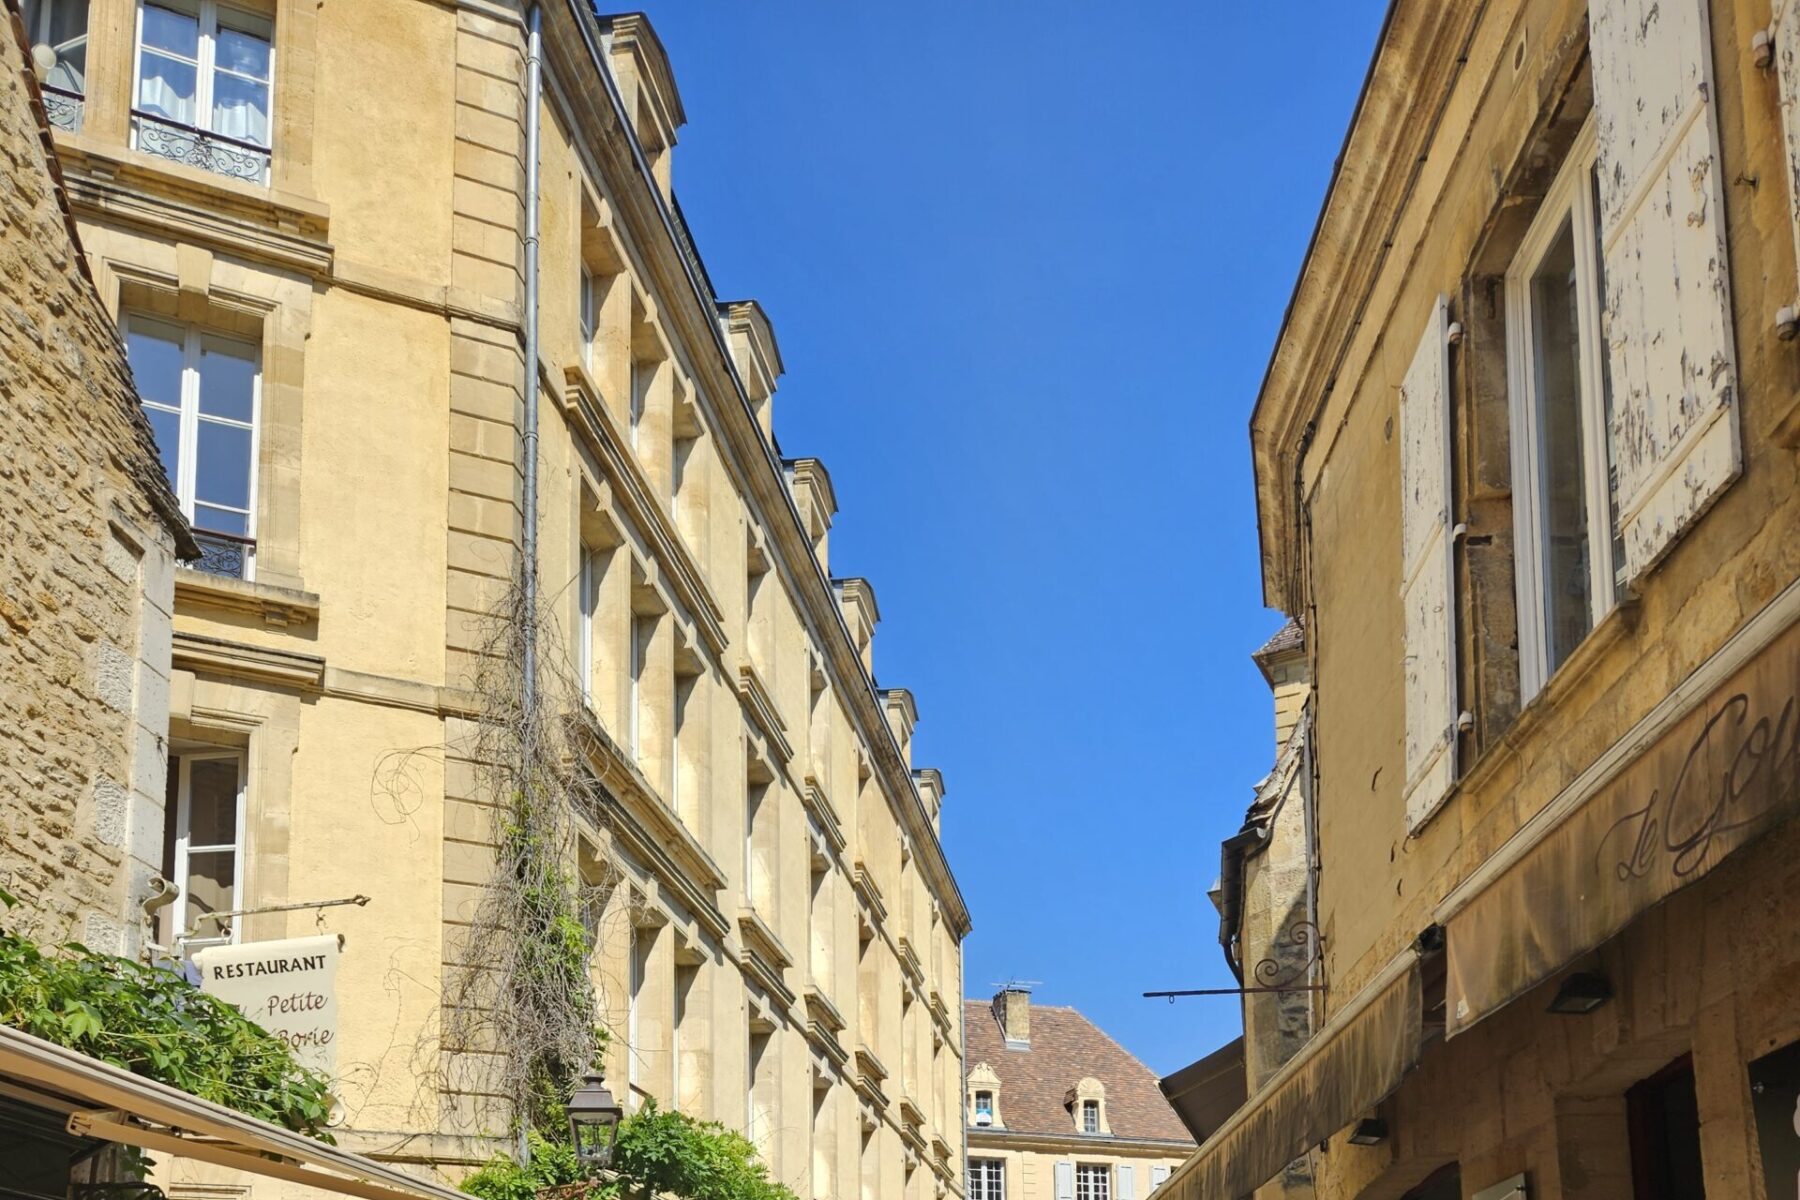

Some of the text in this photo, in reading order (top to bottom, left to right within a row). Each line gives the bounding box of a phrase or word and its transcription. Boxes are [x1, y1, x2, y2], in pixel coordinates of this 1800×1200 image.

[213, 955, 327, 980] RESTAURANT
[267, 991, 329, 1016] Petite
[275, 1027, 335, 1050] Borie
